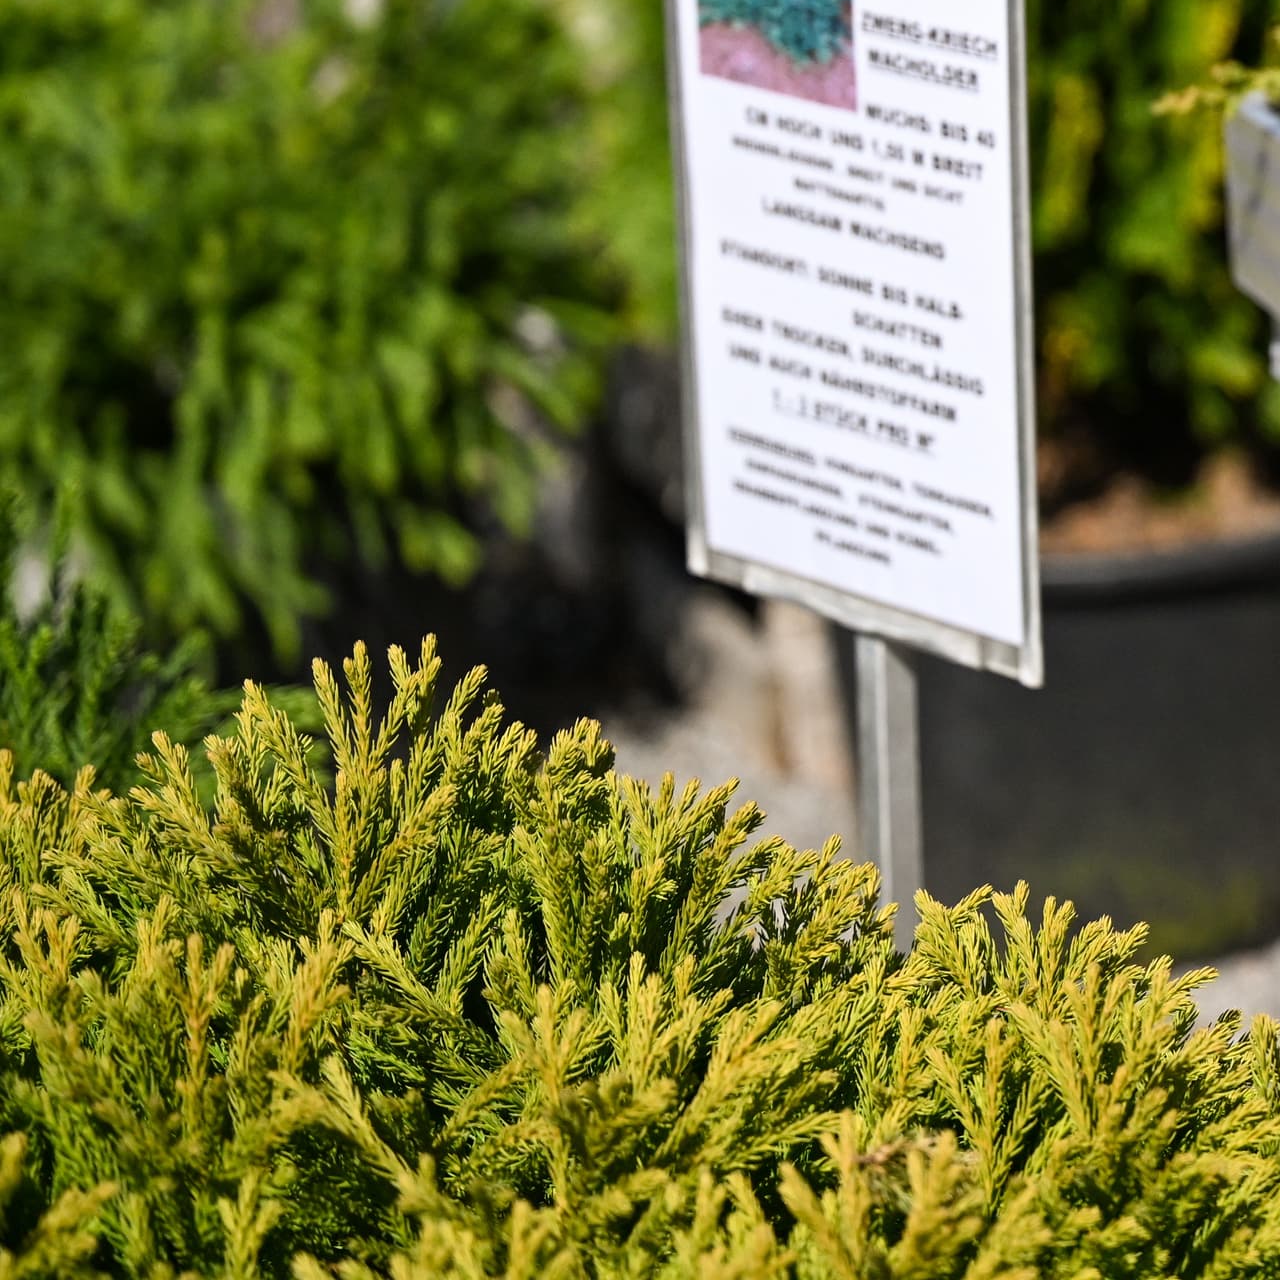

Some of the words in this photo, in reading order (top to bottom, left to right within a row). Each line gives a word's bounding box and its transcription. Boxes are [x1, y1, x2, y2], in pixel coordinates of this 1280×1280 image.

[940, 120, 968, 143] BIS
[931, 153, 983, 179] BREIT
[880, 283, 909, 306] BIS
